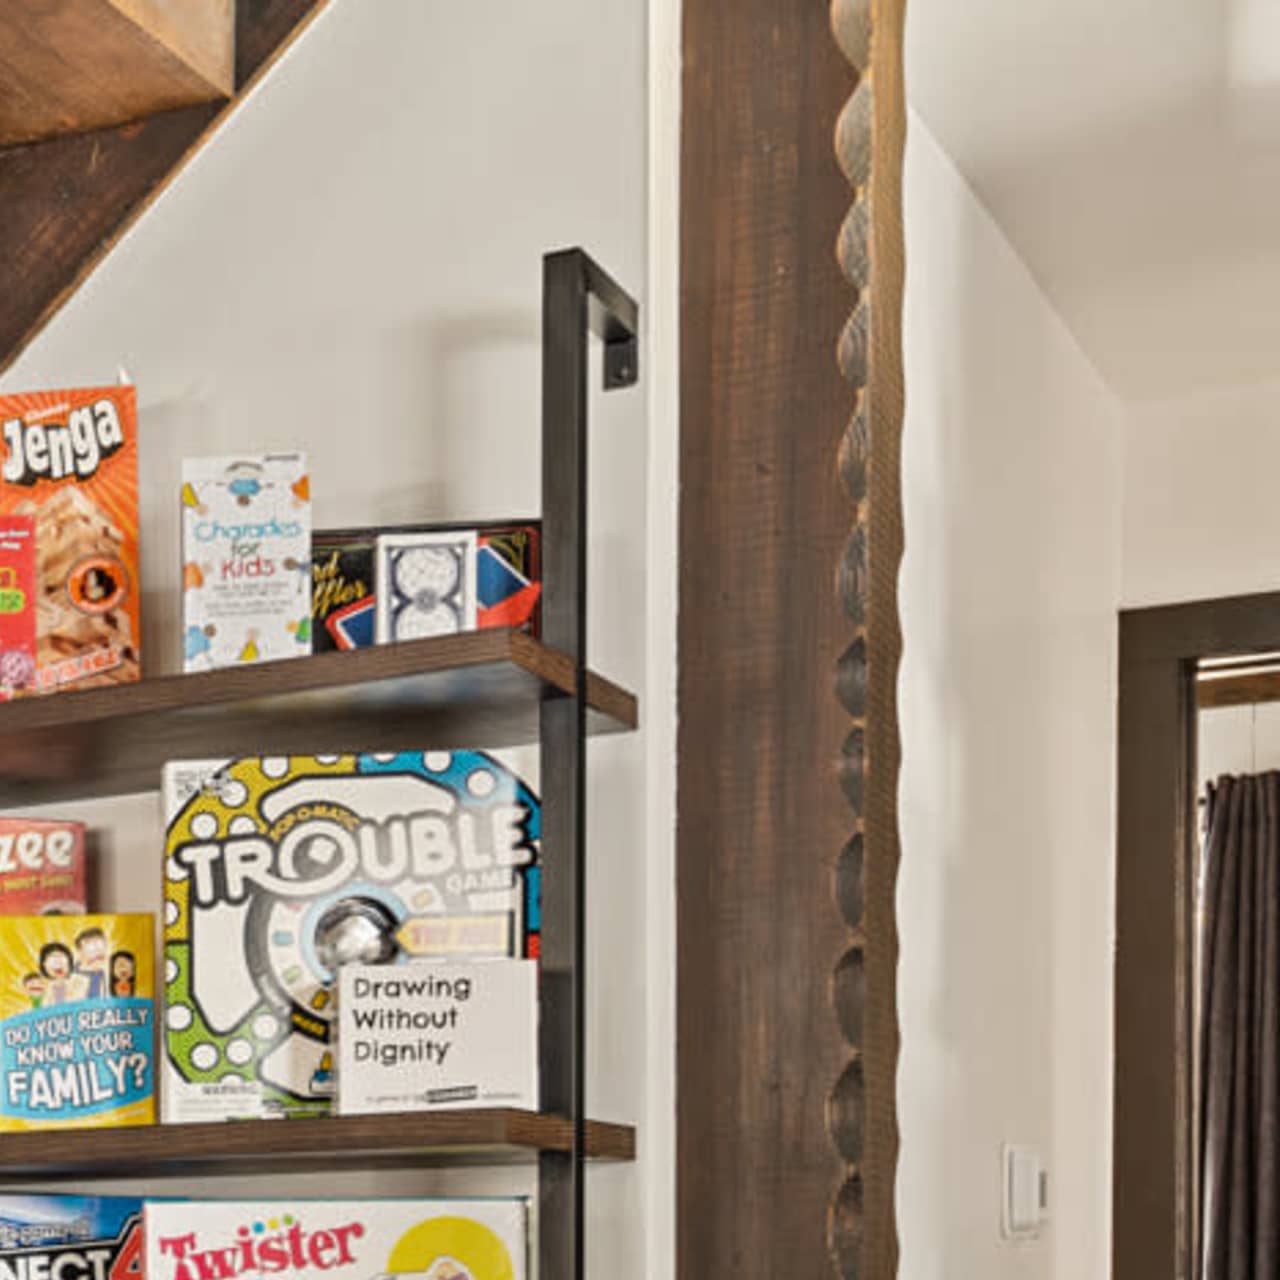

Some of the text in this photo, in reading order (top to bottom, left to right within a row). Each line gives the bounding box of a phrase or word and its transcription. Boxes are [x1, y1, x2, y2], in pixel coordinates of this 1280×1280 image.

[2, 399, 124, 483] Jenga
[193, 517, 303, 542] Charades
[231, 541, 260, 557] for
[220, 557, 276, 580] Kids
[178, 804, 535, 907] TROUBLE
[354, 976, 472, 1001] Drawing
[5, 1007, 148, 1046] DO YOU REALLY
[352, 1005, 458, 1030] Without
[17, 1031, 133, 1065] KNOW YOUR
[354, 1040, 452, 1066] Dignity
[7, 1052, 148, 1109] FAMILY?
